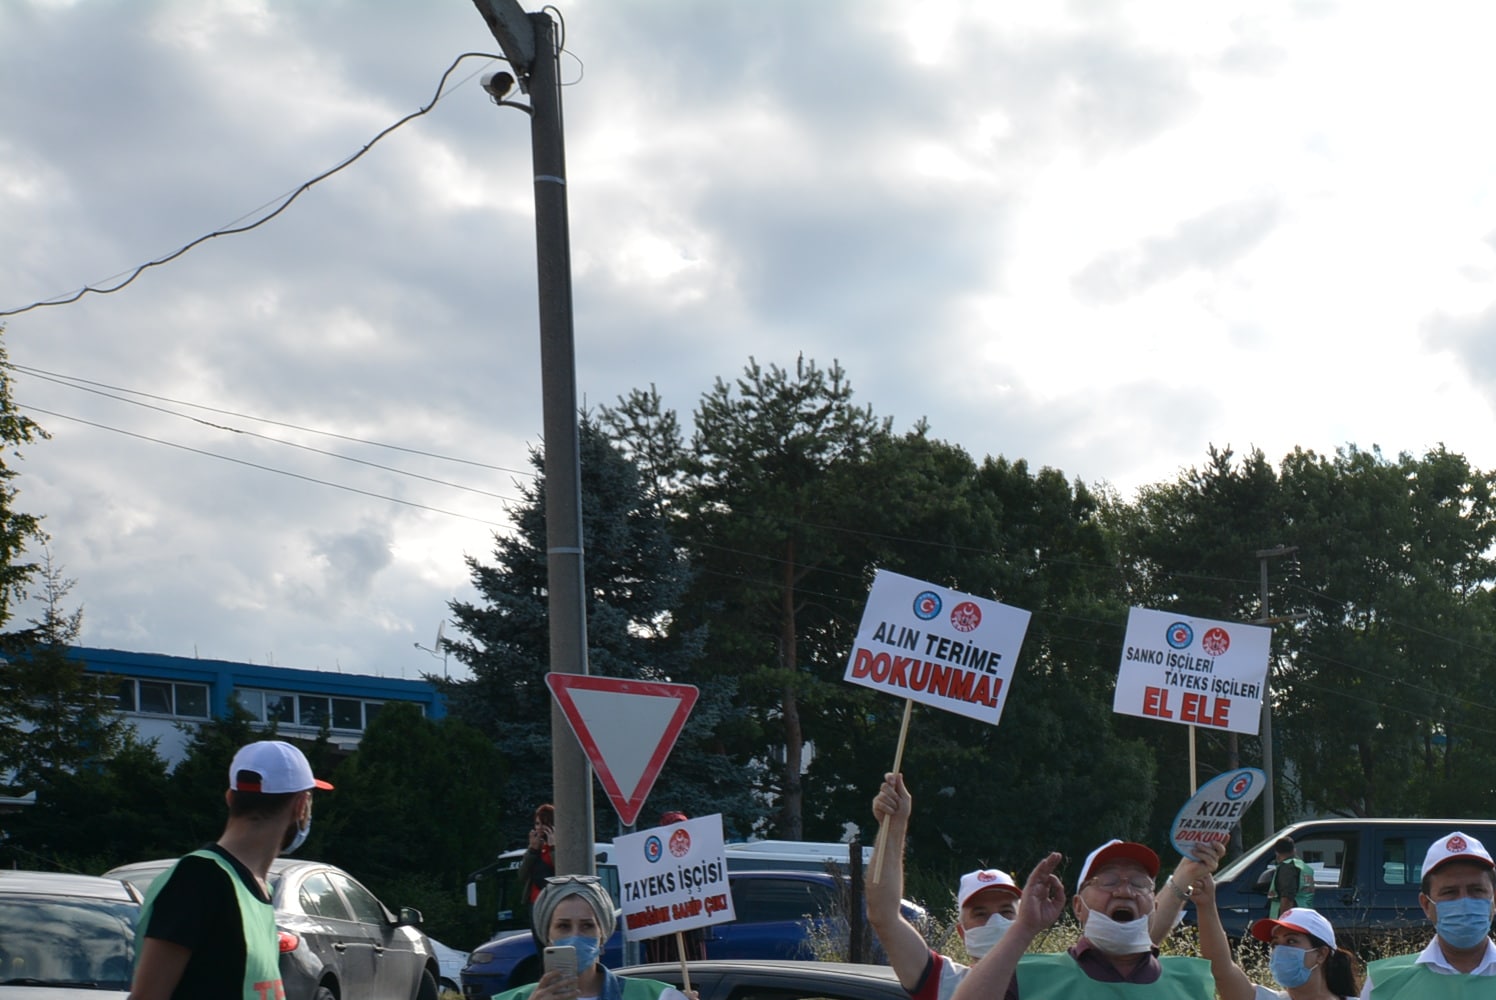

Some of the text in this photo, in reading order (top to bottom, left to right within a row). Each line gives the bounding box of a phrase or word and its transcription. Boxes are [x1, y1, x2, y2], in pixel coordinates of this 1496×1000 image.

[872, 621, 1002, 675] ALIN TERİME
[1126, 646, 1164, 665] SANKO
[1166, 649, 1215, 674] İŞÇİLERİ
[851, 648, 1003, 708] DOKUNMA!
[1165, 671, 1261, 700] TAYEKS İŞÇİLERİ
[1142, 686, 1231, 728] EL ELE
[1175, 830, 1227, 843] DOKUN
[1179, 818, 1236, 832] TAZMİNAT
[623, 856, 723, 902] TAYEKS İŞÇİSİ
